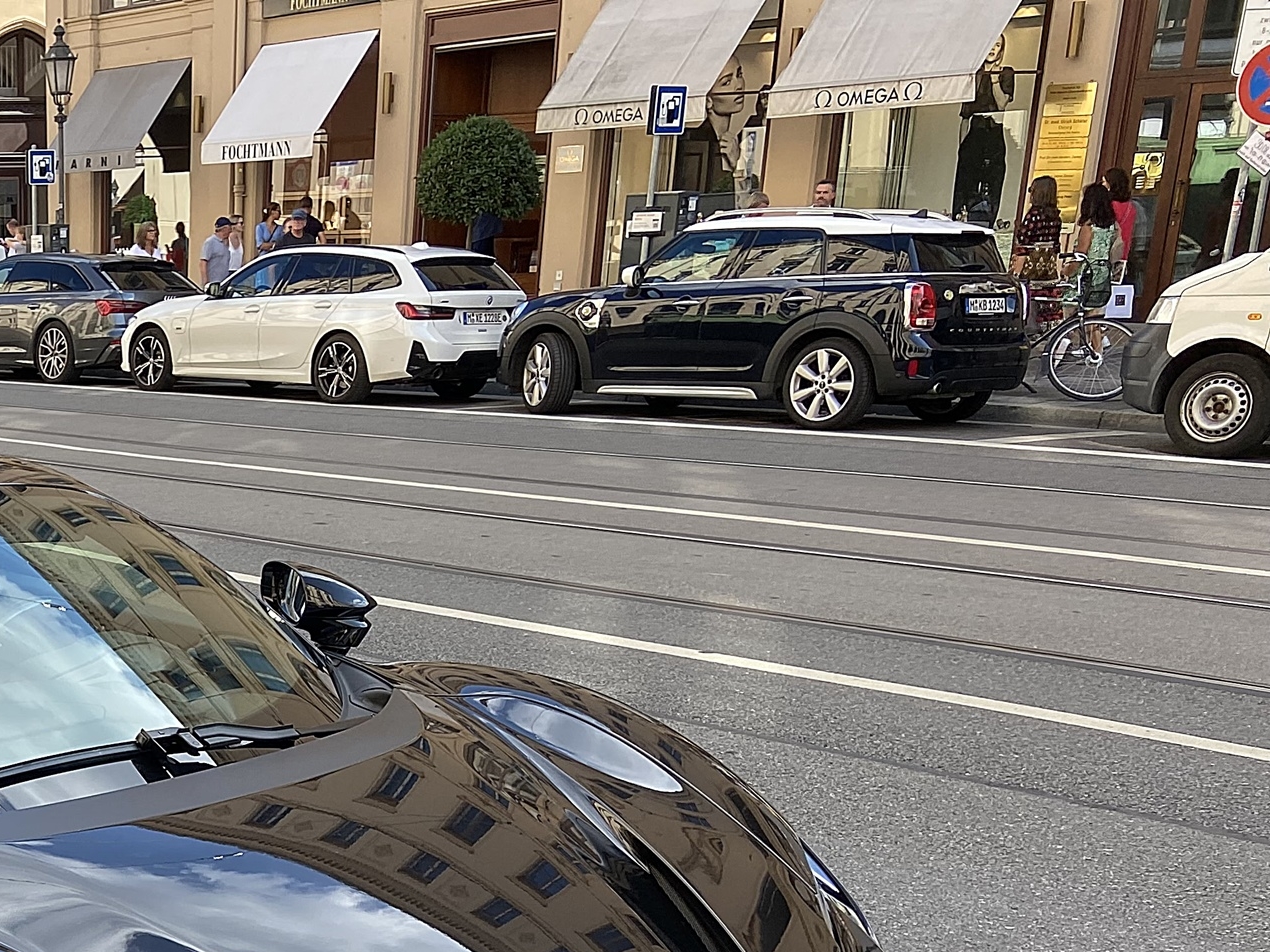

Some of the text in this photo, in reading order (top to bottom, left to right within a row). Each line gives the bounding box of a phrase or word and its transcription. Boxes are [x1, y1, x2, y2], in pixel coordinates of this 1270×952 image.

[837, 87, 899, 107] OMEGA
[592, 107, 644, 124] OMEGA
[221, 140, 292, 161] FOCHTMANN
[988, 299, 1004, 311] 1234
